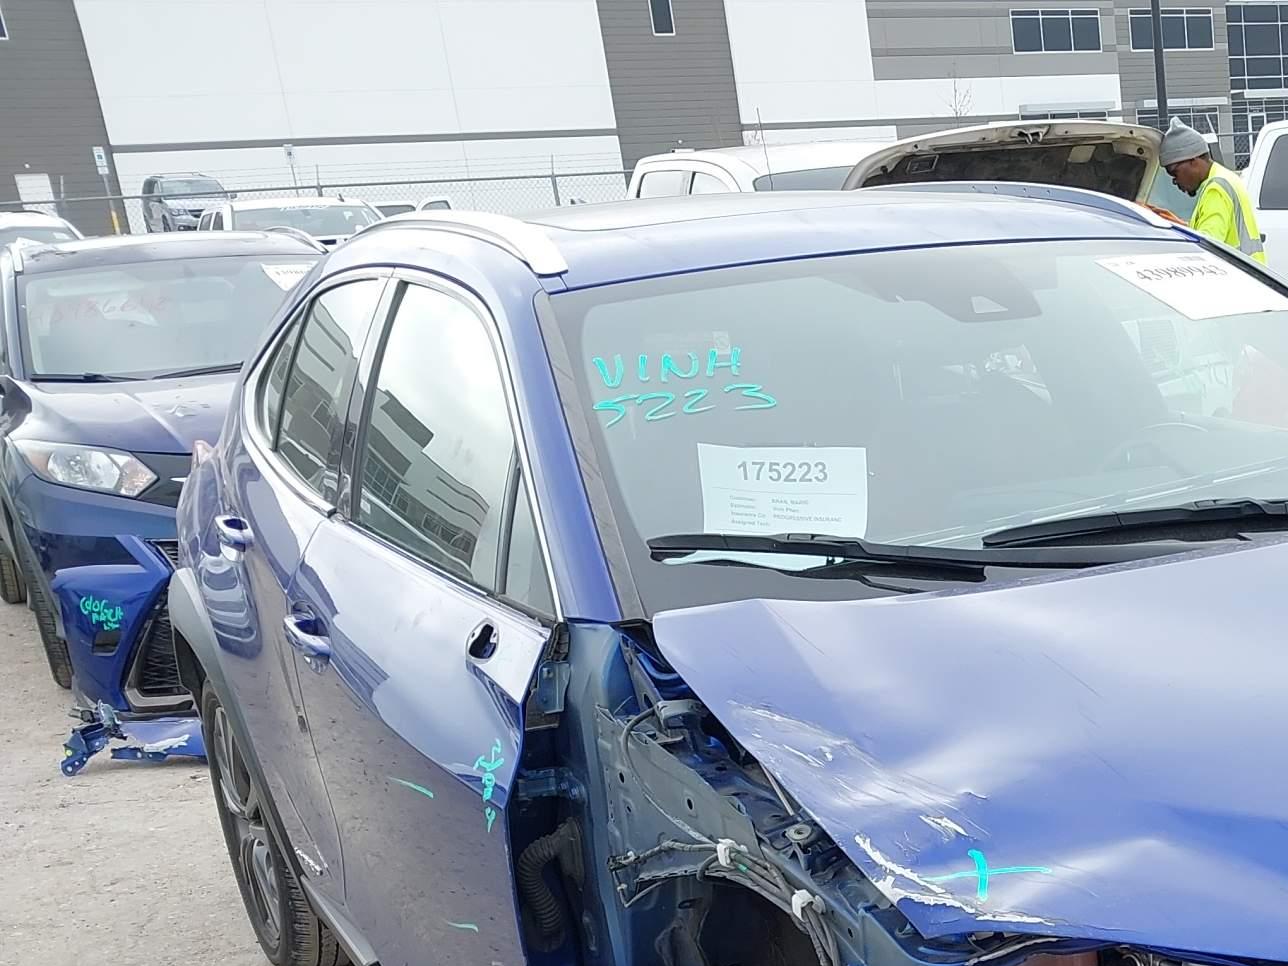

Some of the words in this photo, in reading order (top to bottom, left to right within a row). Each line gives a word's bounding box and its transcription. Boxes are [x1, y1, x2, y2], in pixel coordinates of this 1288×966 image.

[592, 346, 742, 389] VINH
[592, 383, 777, 428] 5223
[737, 460, 829, 483] 175223
